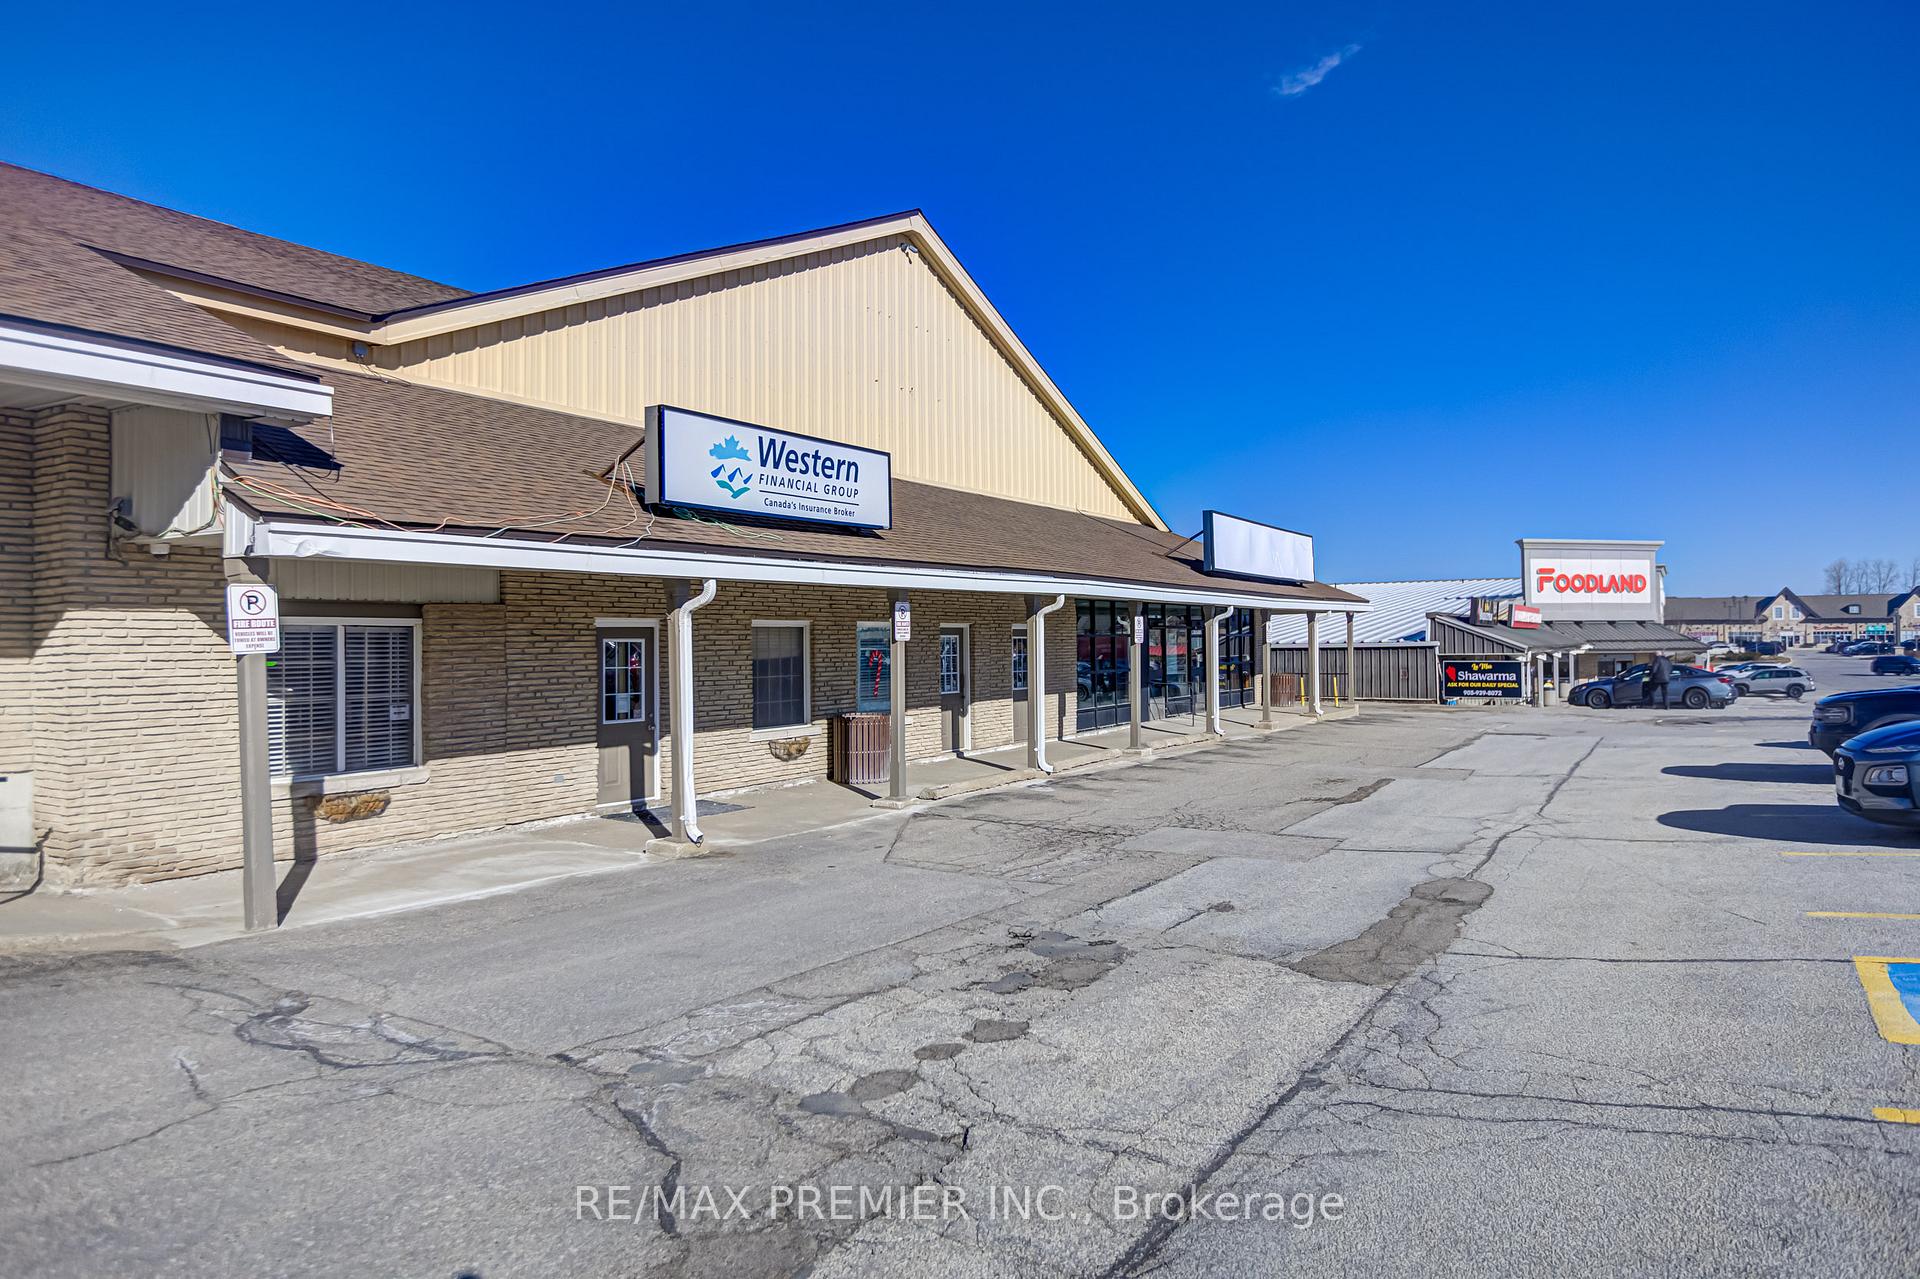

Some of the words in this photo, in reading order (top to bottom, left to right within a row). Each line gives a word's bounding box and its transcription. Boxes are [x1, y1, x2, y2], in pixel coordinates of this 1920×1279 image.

[758, 436, 859, 483] Western
[759, 473, 818, 493] FINANCIAL
[823, 484, 859, 499] GROUP
[764, 497, 797, 510] Canada's
[798, 502, 832, 515] Insurance
[833, 506, 855, 517] Broker
[1536, 567, 1646, 594] FOODLAND
[233, 620, 250, 628] FIRE
[251, 619, 276, 628] ROUTE
[1457, 670, 1517, 681] Shawarma
